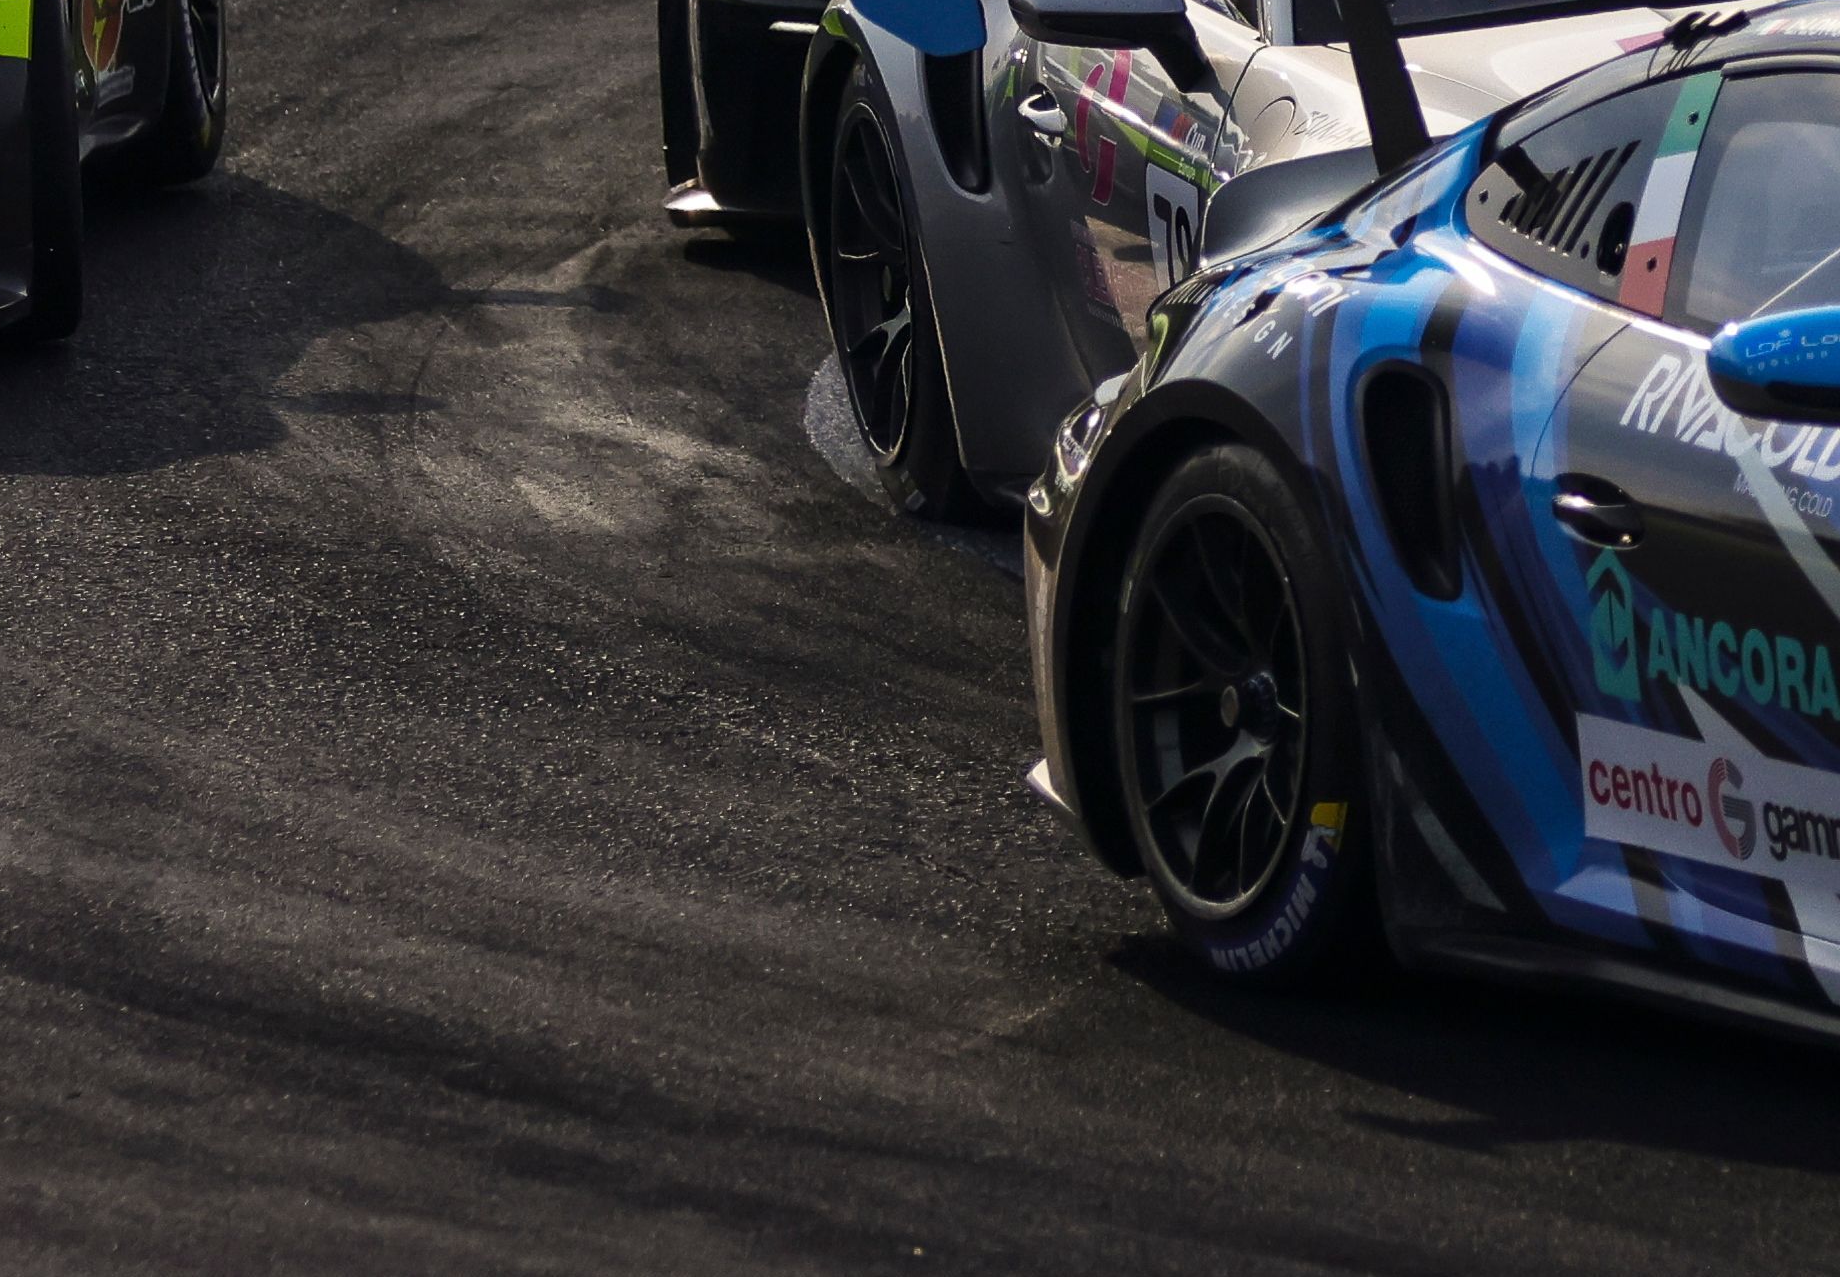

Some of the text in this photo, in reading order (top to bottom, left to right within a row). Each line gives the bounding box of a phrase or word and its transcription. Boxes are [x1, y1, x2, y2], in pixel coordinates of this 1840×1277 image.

[1796, 490, 1834, 518] COLD
[1588, 756, 1705, 829] centro
[1210, 872, 1318, 971] MICHELIN
